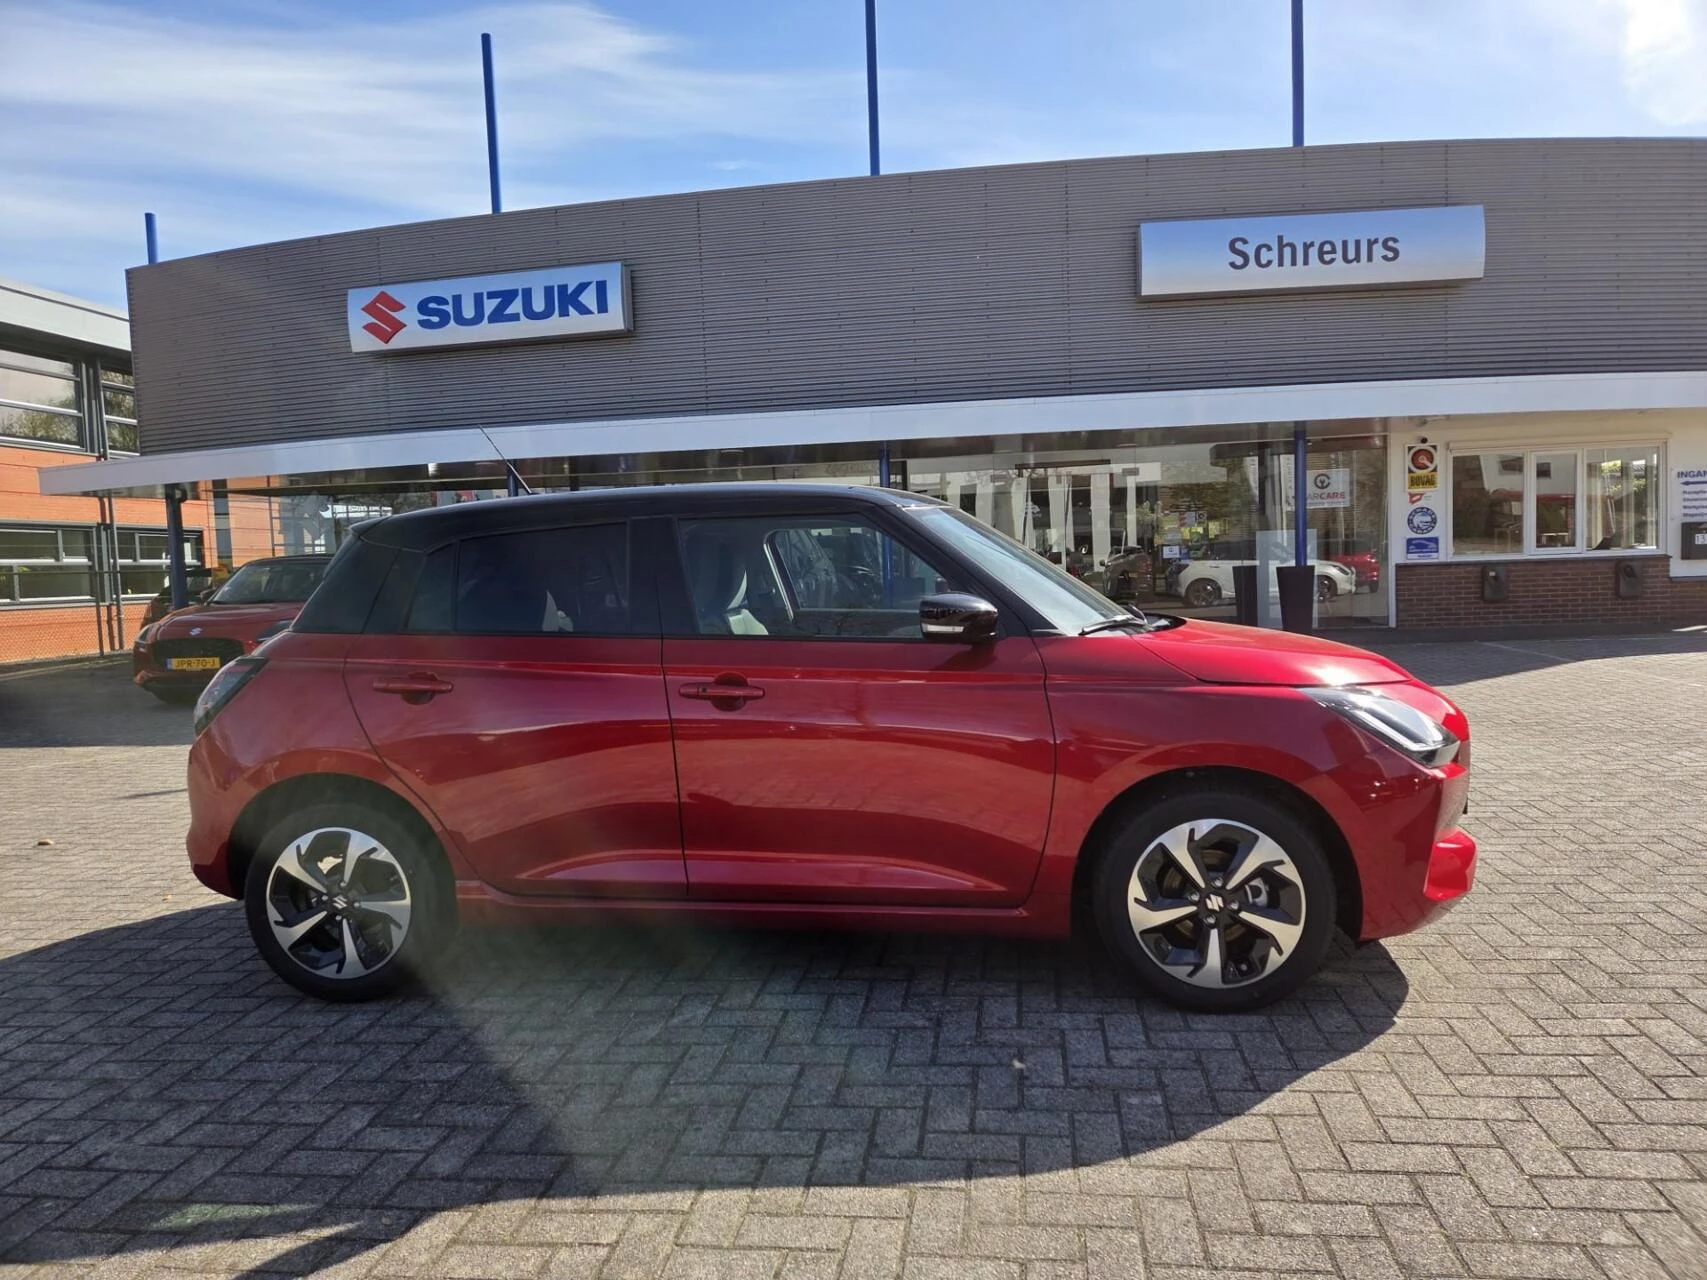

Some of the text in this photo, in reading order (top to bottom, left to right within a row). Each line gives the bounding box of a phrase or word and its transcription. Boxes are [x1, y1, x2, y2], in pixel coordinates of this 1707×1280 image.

[1227, 235, 1401, 271] Schreurs
[416, 279, 609, 330] SUZUKI
[174, 659, 216, 668] JPR-70-J
